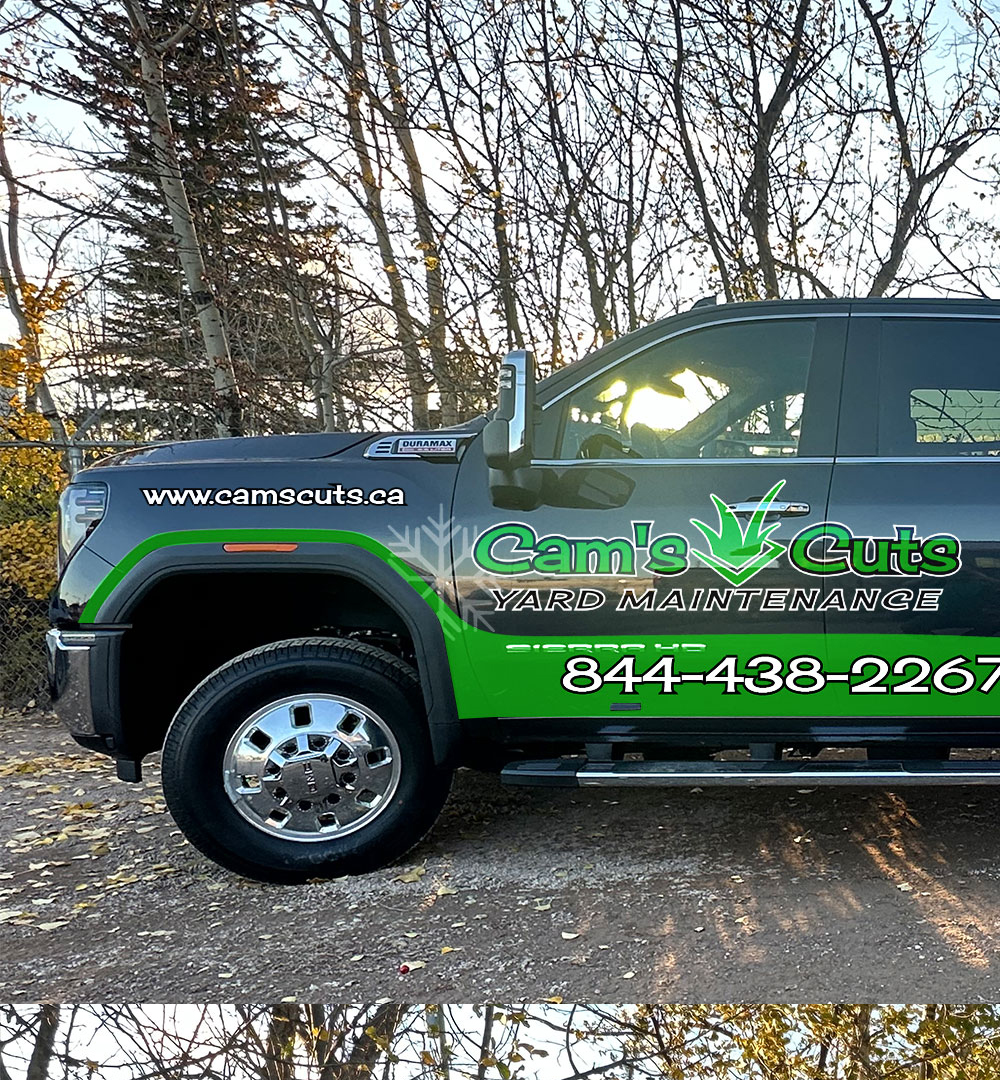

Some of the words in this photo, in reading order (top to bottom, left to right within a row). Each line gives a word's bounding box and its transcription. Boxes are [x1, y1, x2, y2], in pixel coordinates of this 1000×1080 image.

[142, 484, 405, 505] www.camscuts.ca
[471, 520, 690, 577] Cam's
[788, 521, 962, 577] Cuts
[490, 588, 606, 611] YARD
[615, 588, 944, 611] MAINTENANCE
